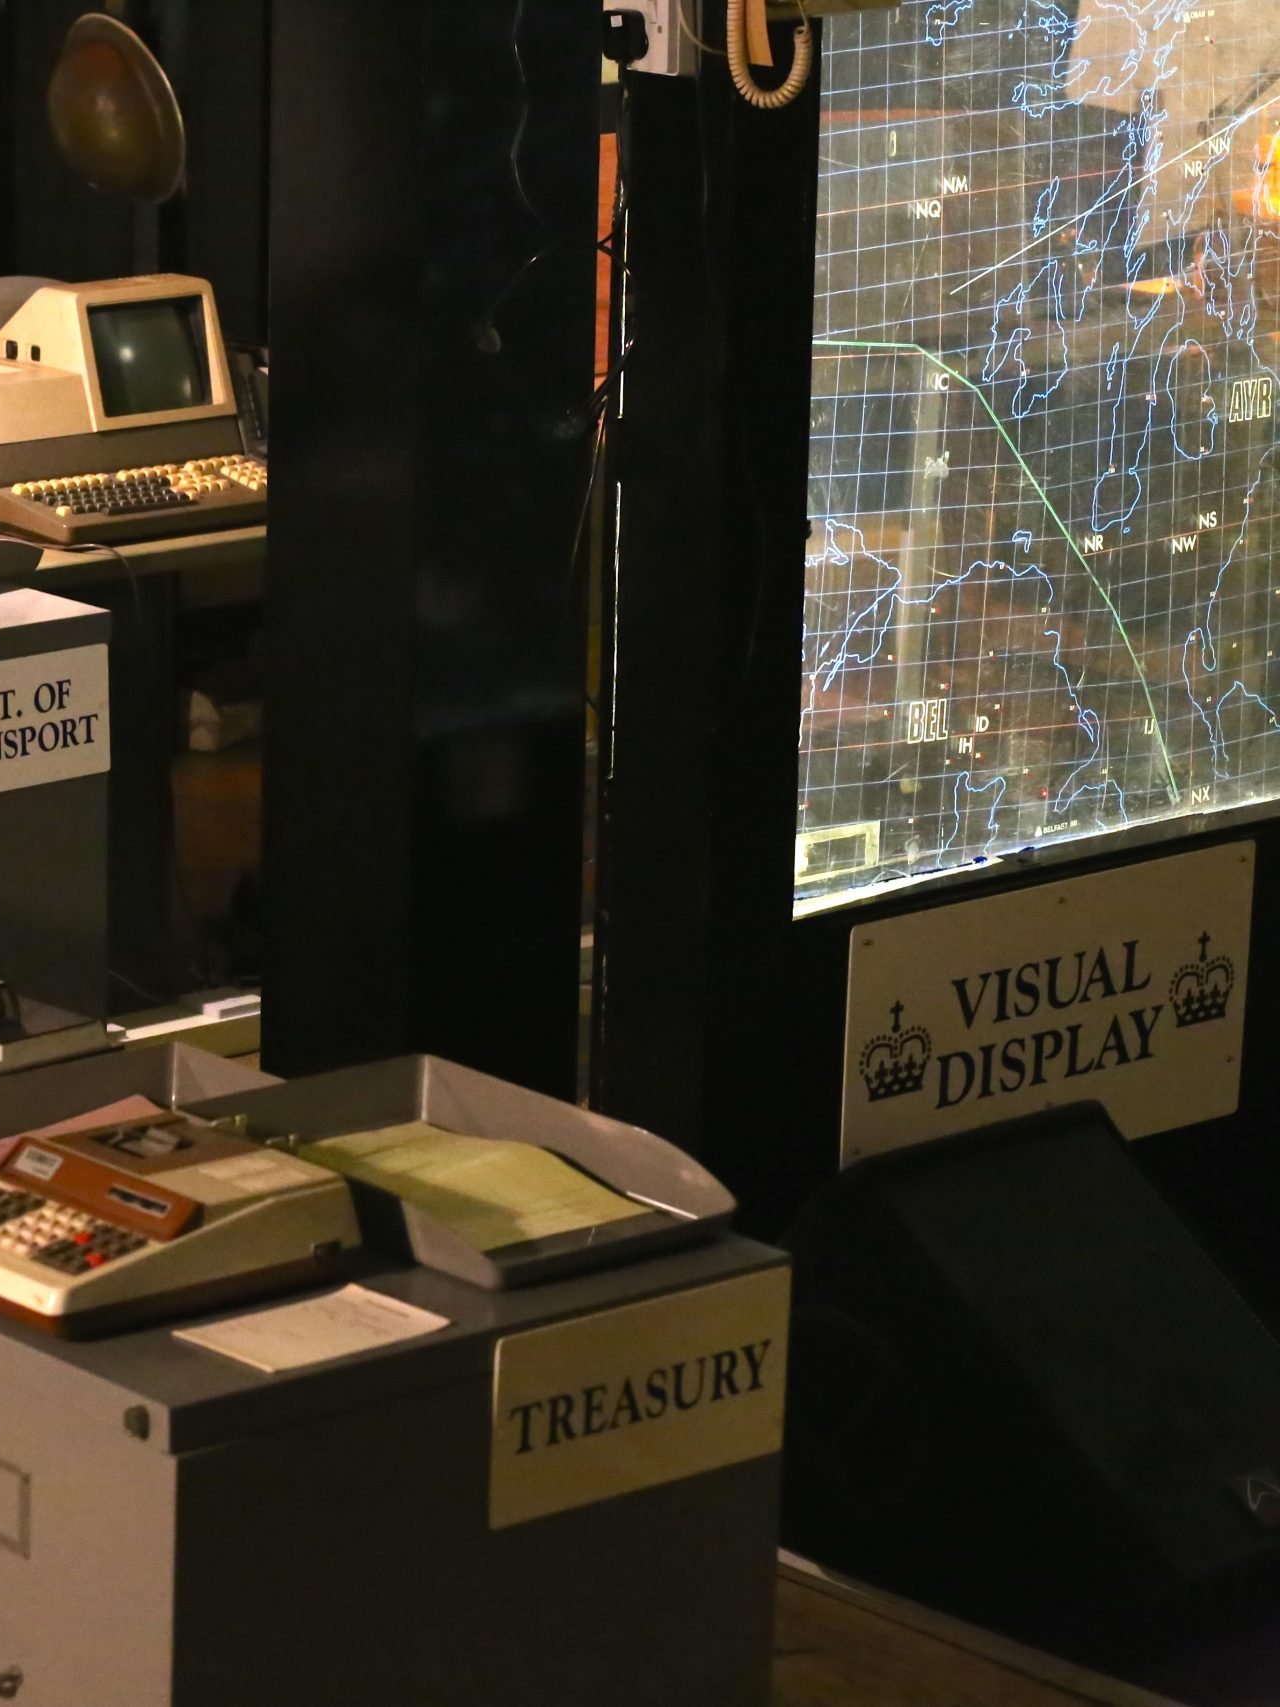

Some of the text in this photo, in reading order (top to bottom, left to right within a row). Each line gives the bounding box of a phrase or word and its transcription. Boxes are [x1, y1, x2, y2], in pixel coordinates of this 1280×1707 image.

[943, 175, 968, 195] NM
[916, 200, 941, 220] NQ
[1228, 377, 1272, 423] AYR
[1199, 511, 1217, 529] NS
[1084, 535, 1104, 553] NR
[1172, 534, 1197, 554] NW
[33, 679, 72, 714] OF
[907, 698, 949, 744] BEL
[975, 716, 990, 732] ID
[958, 737, 973, 754] IH
[1191, 785, 1211, 806] NX
[951, 939, 1152, 1030] VISUAL
[935, 1004, 1165, 1109] DISPLAY
[508, 1338, 772, 1455] TREASURY
